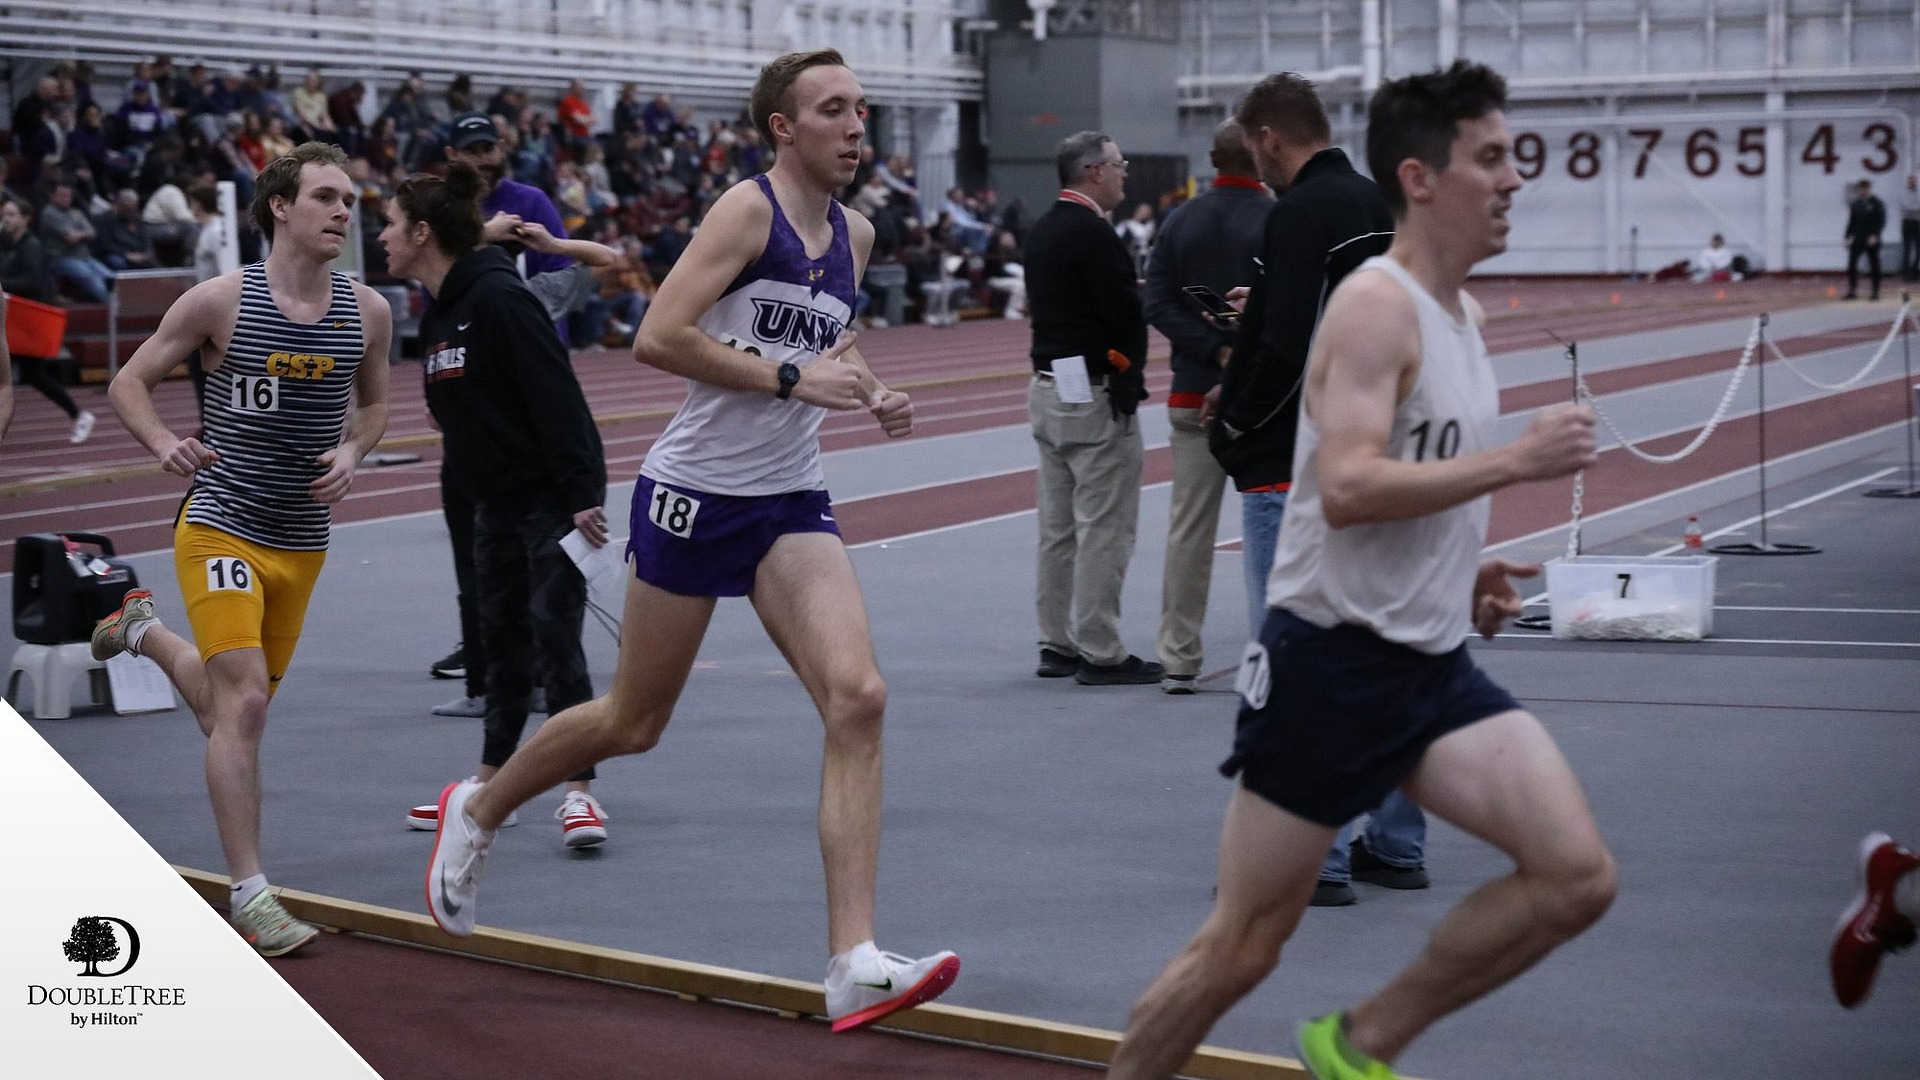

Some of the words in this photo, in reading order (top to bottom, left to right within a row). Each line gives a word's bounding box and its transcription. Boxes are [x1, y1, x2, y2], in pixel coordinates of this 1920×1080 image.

[1514, 132, 1546, 180] 9
[1567, 130, 1601, 179] 8
[1628, 128, 1664, 178] 7
[1685, 127, 1720, 178] 6
[1736, 126, 1767, 177] 5
[1802, 123, 1841, 175] 4
[1862, 122, 1898, 174] 3
[750, 298, 844, 354] UNW
[266, 352, 335, 380] CSP
[235, 377, 273, 410] 16
[1408, 418, 1461, 463] 10
[656, 490, 692, 533] 18
[211, 559, 248, 589] 16
[1617, 573, 1632, 599] 7
